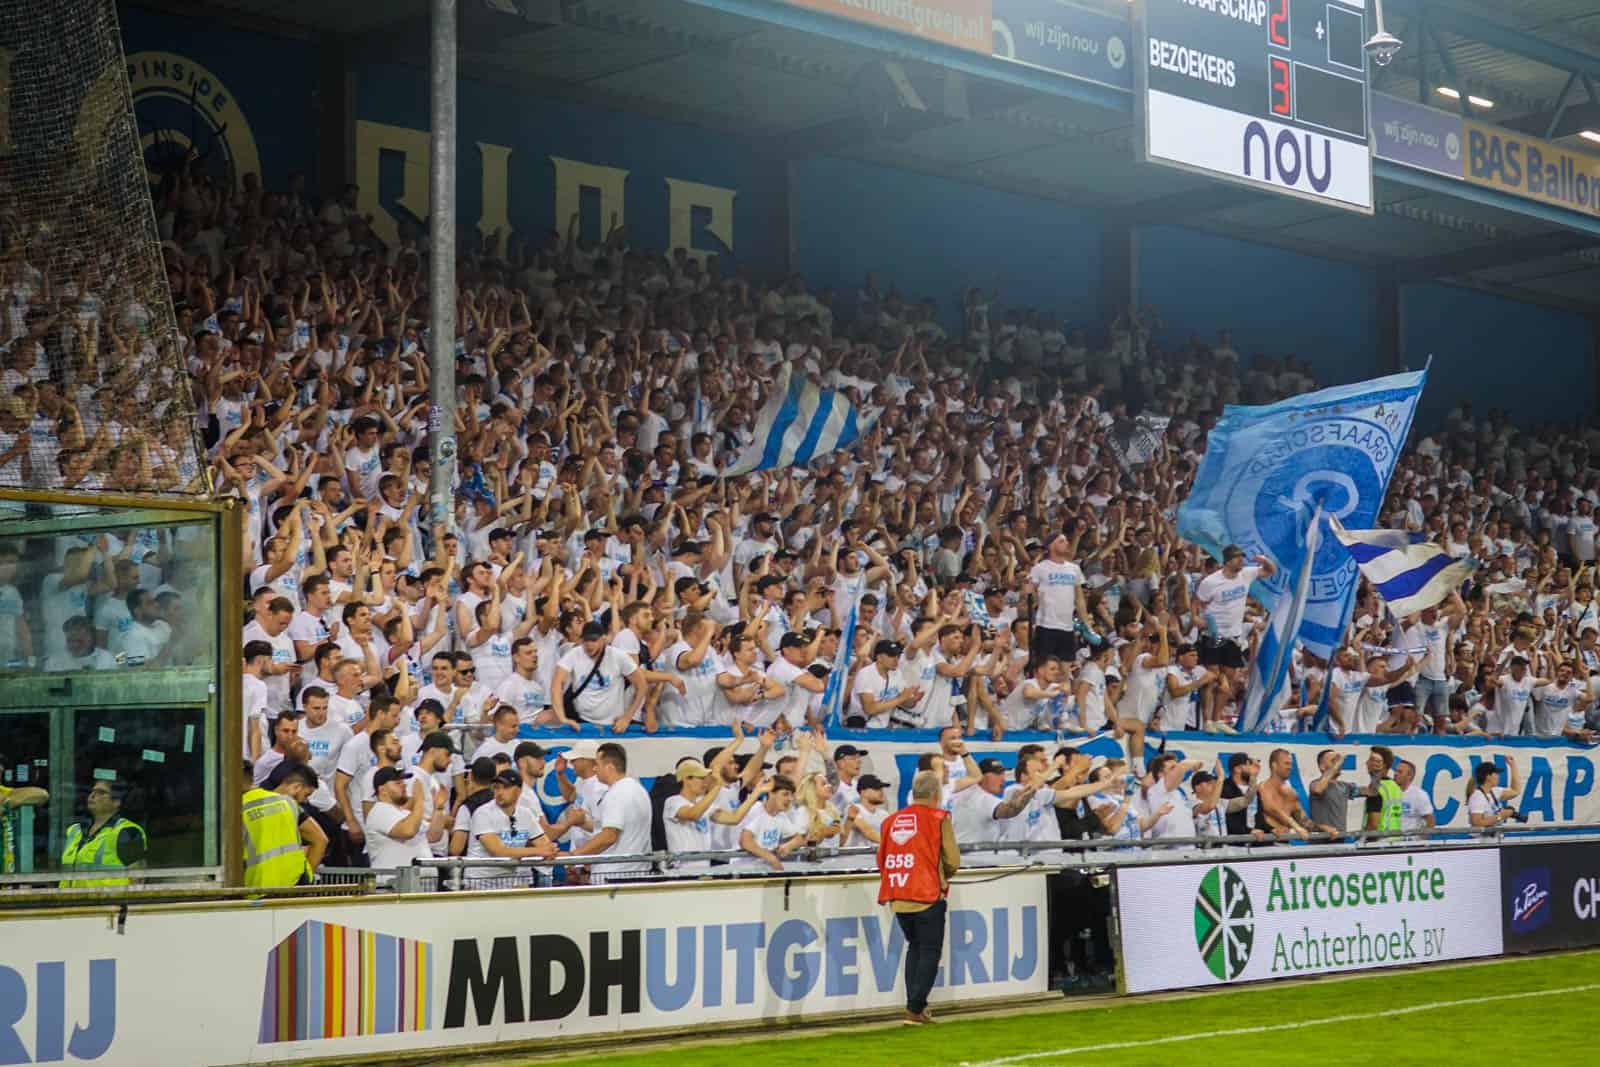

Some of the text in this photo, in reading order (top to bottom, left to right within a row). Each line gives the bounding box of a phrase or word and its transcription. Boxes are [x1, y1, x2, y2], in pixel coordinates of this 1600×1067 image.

[1024, 21, 1044, 46] wij
[1047, 25, 1071, 51] zijn
[127, 60, 227, 112] PINSIDE
[1150, 38, 1290, 114] BEZOEKERS 3
[1243, 120, 1332, 193] nou
[1469, 129, 1521, 186] BAS
[885, 854, 914, 868] 658
[888, 873, 909, 887] TV
[1266, 855, 1445, 912] Aircoservice
[443, 905, 1038, 1029] MDHUITGEVRIJ
[1271, 918, 1445, 972] Achterhoek BV
